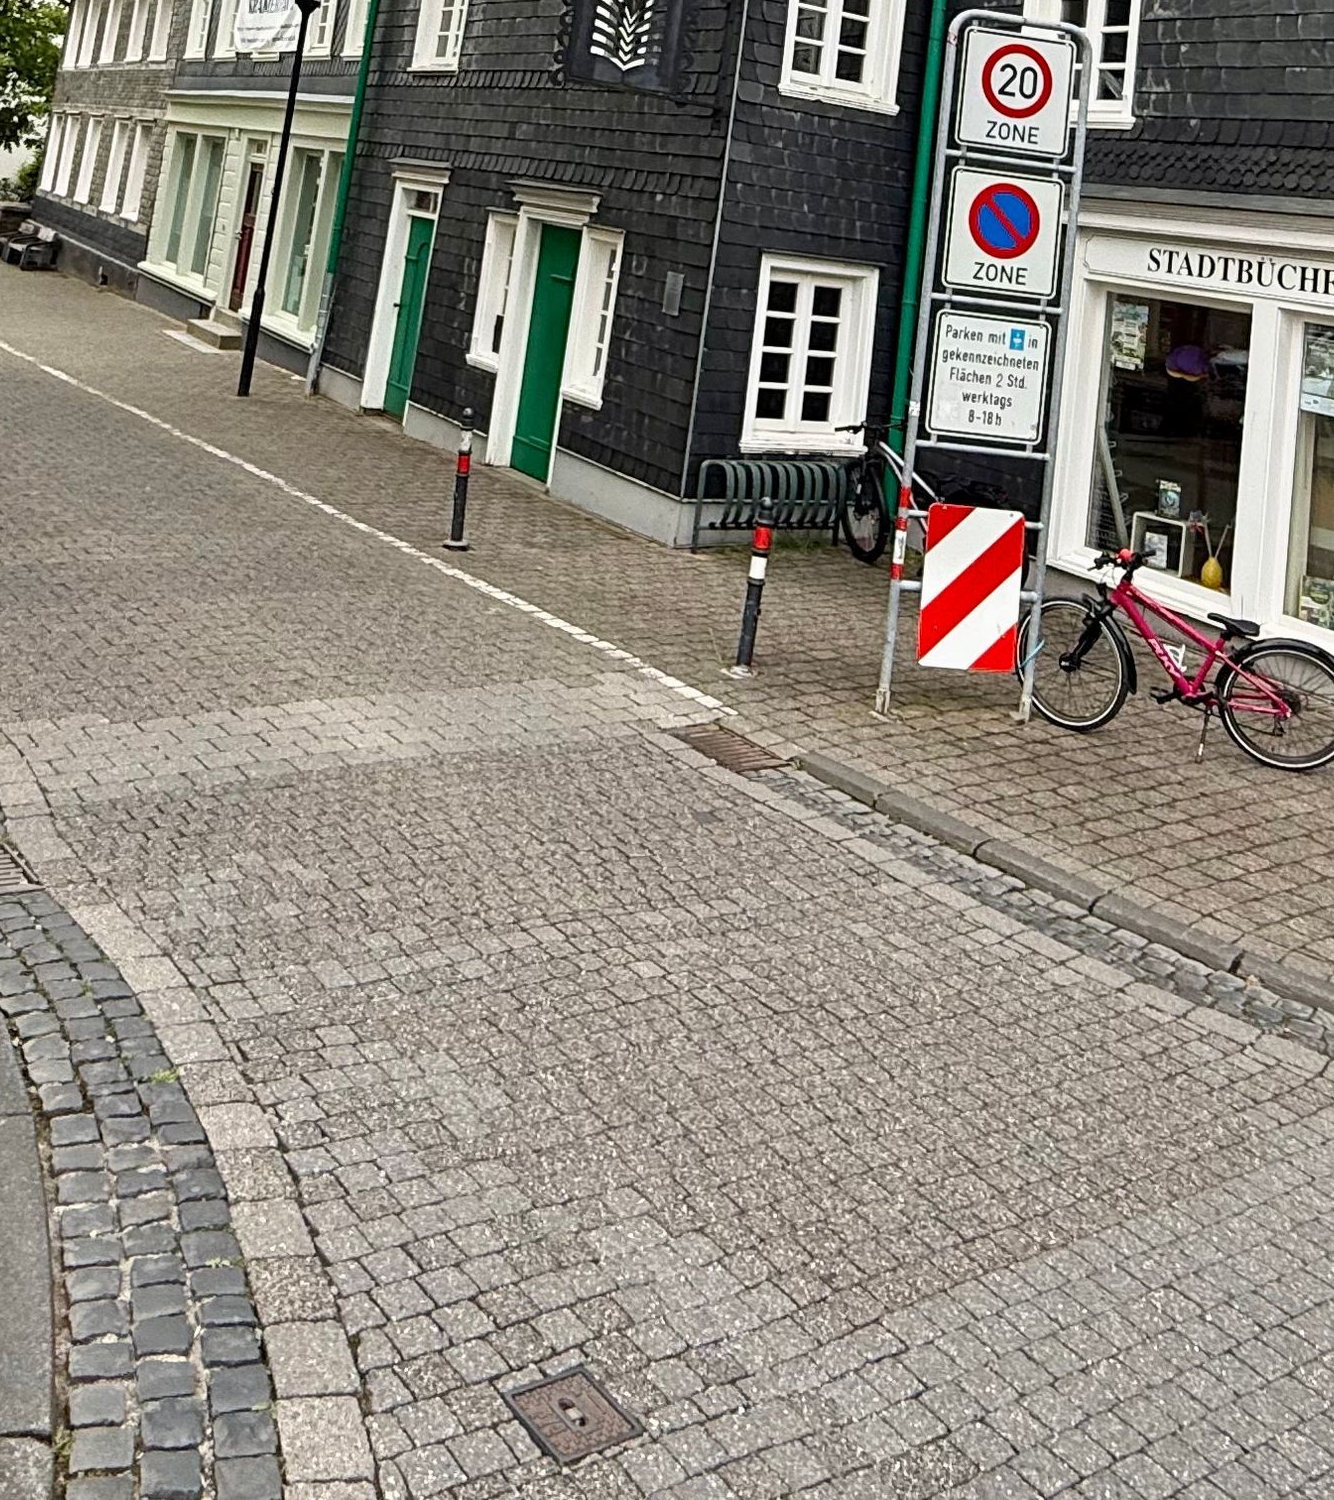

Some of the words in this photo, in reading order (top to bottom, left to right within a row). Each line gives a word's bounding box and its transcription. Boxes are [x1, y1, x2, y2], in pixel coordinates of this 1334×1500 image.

[997, 63, 1038, 100] 20
[985, 120, 1040, 145] ZONE
[972, 262, 1028, 286] ZONE
[945, 324, 984, 342] Parken
[987, 332, 1007, 345] mit
[1028, 337, 1038, 349] in
[942, 348, 1039, 371] gekennzeichneten
[949, 367, 992, 385] Flächen
[995, 373, 1004, 388] 2
[1007, 374, 1028, 389] Std.
[962, 391, 1013, 410] werktags
